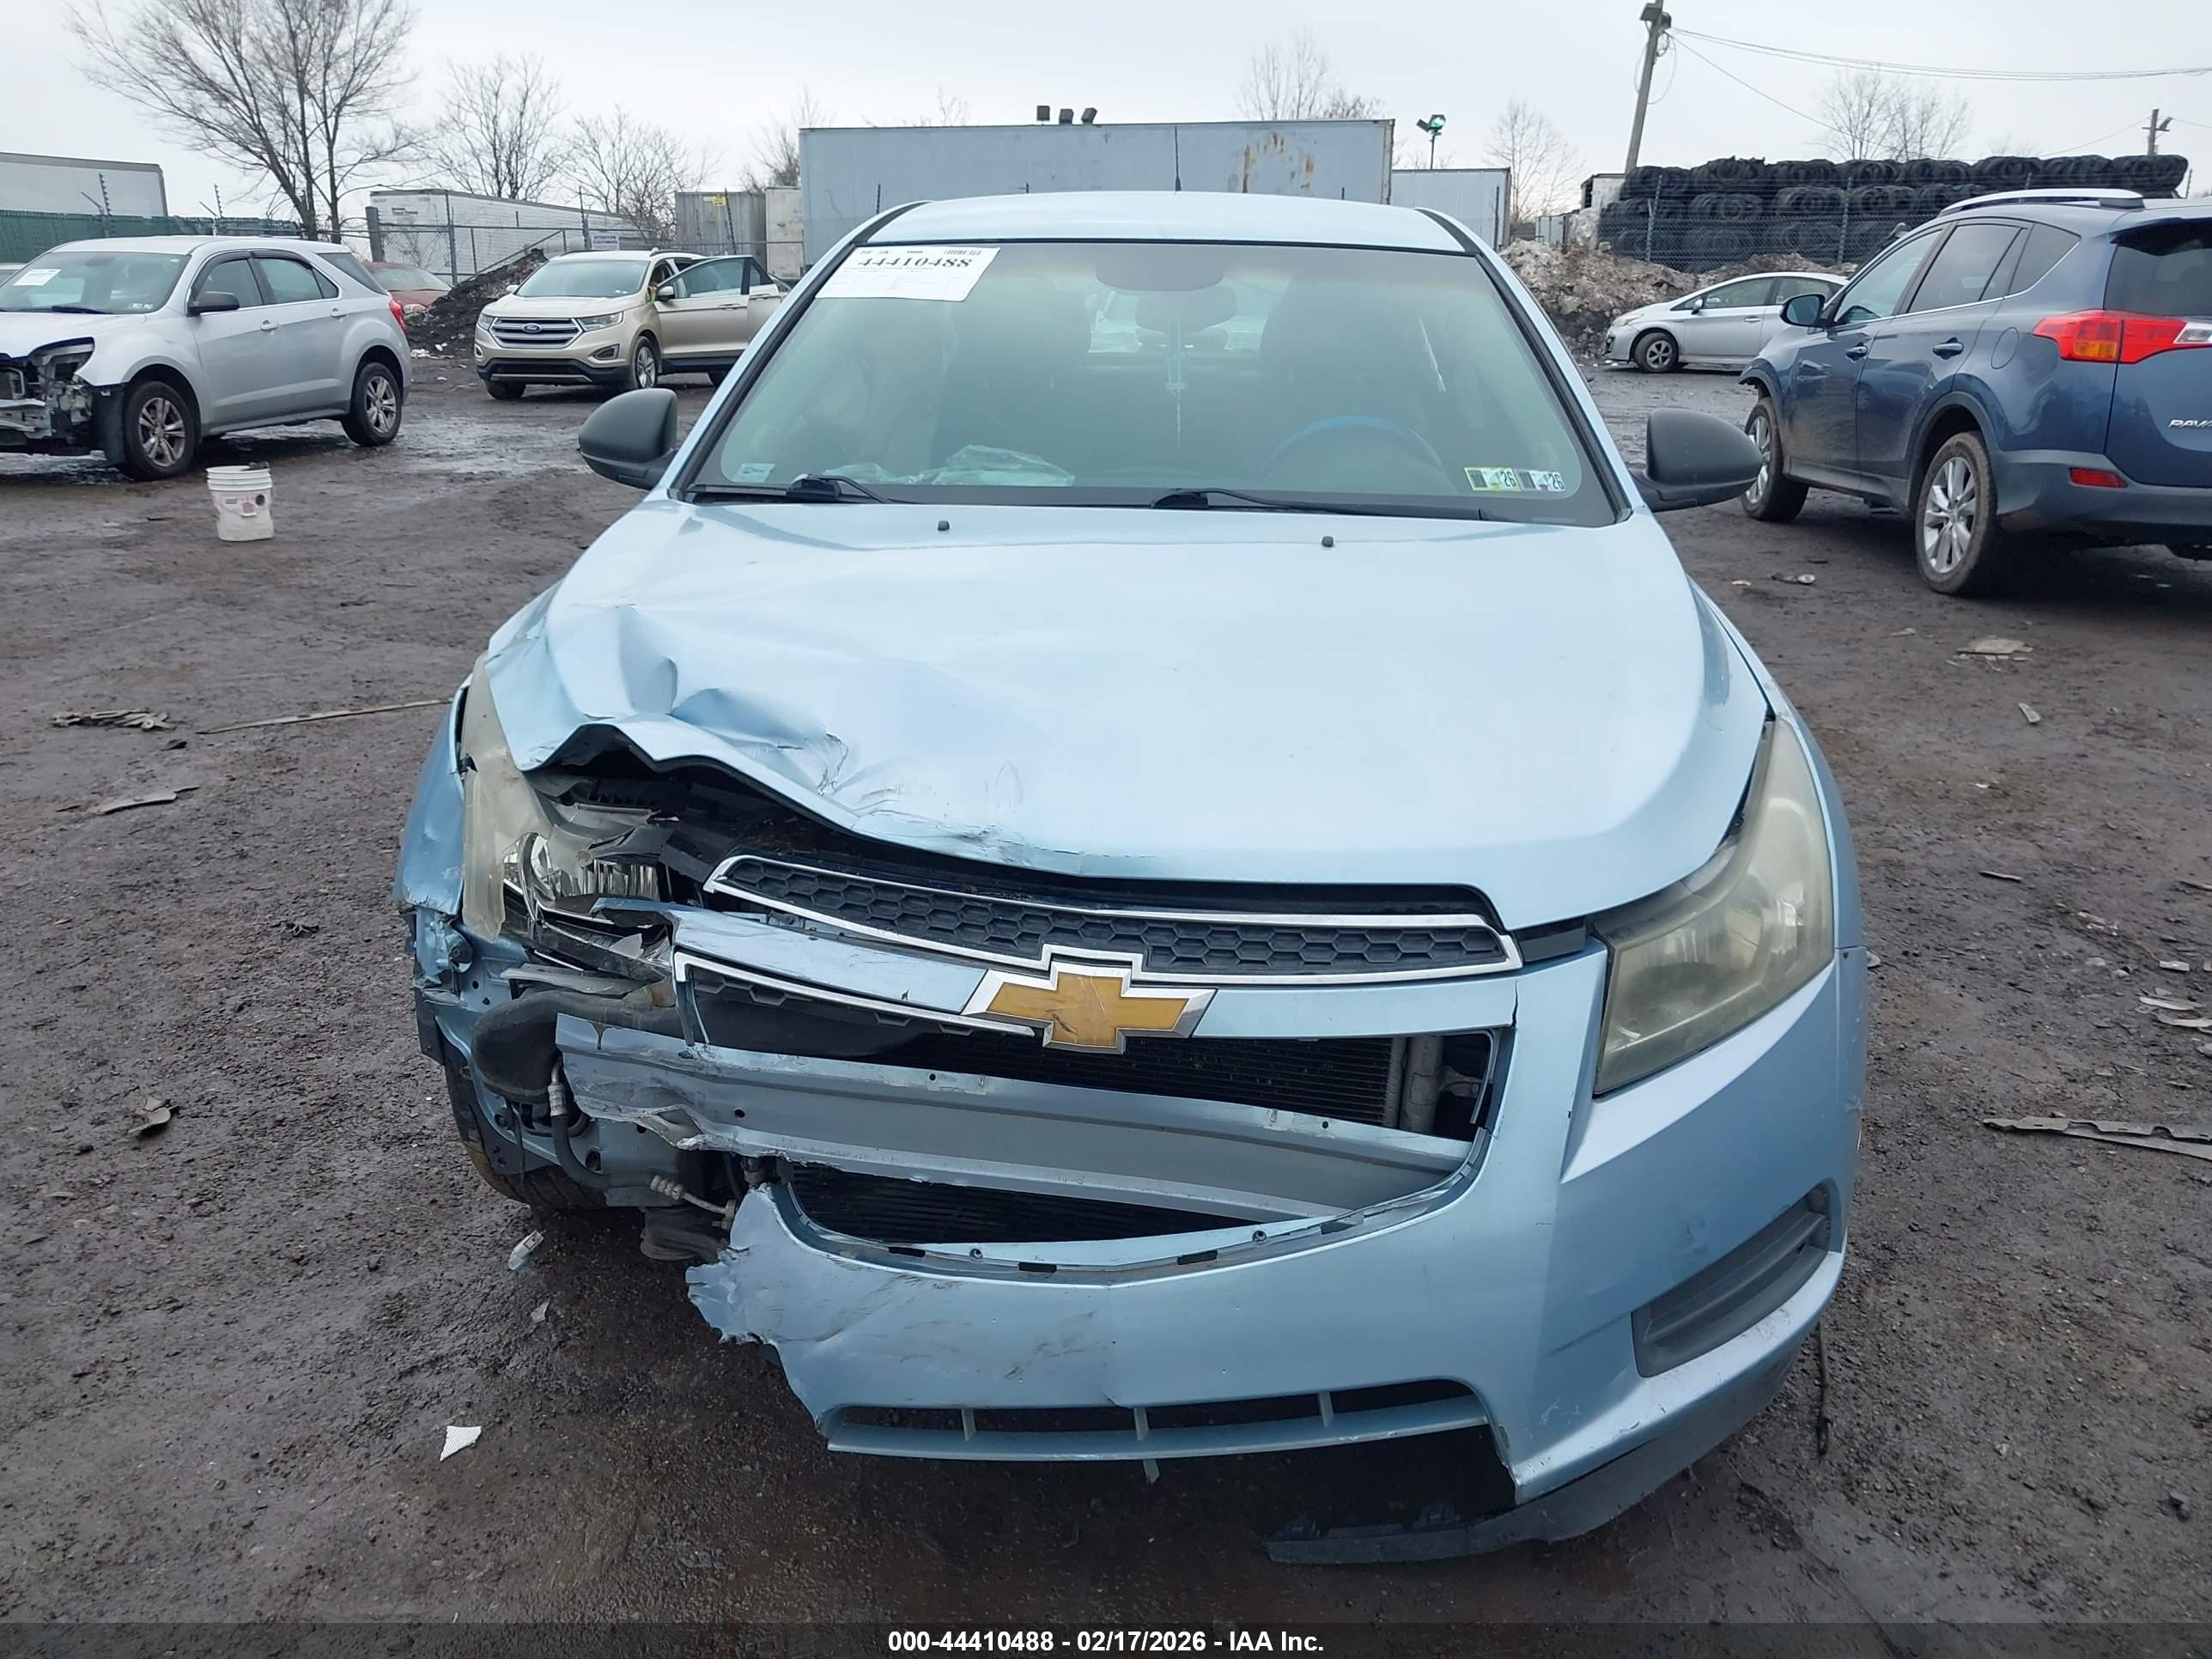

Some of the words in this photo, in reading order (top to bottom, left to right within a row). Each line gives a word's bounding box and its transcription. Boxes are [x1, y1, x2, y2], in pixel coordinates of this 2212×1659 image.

[858, 258, 972, 268] 44410488
[1500, 471, 1516, 488] 26
[1548, 473, 1565, 489] 26
